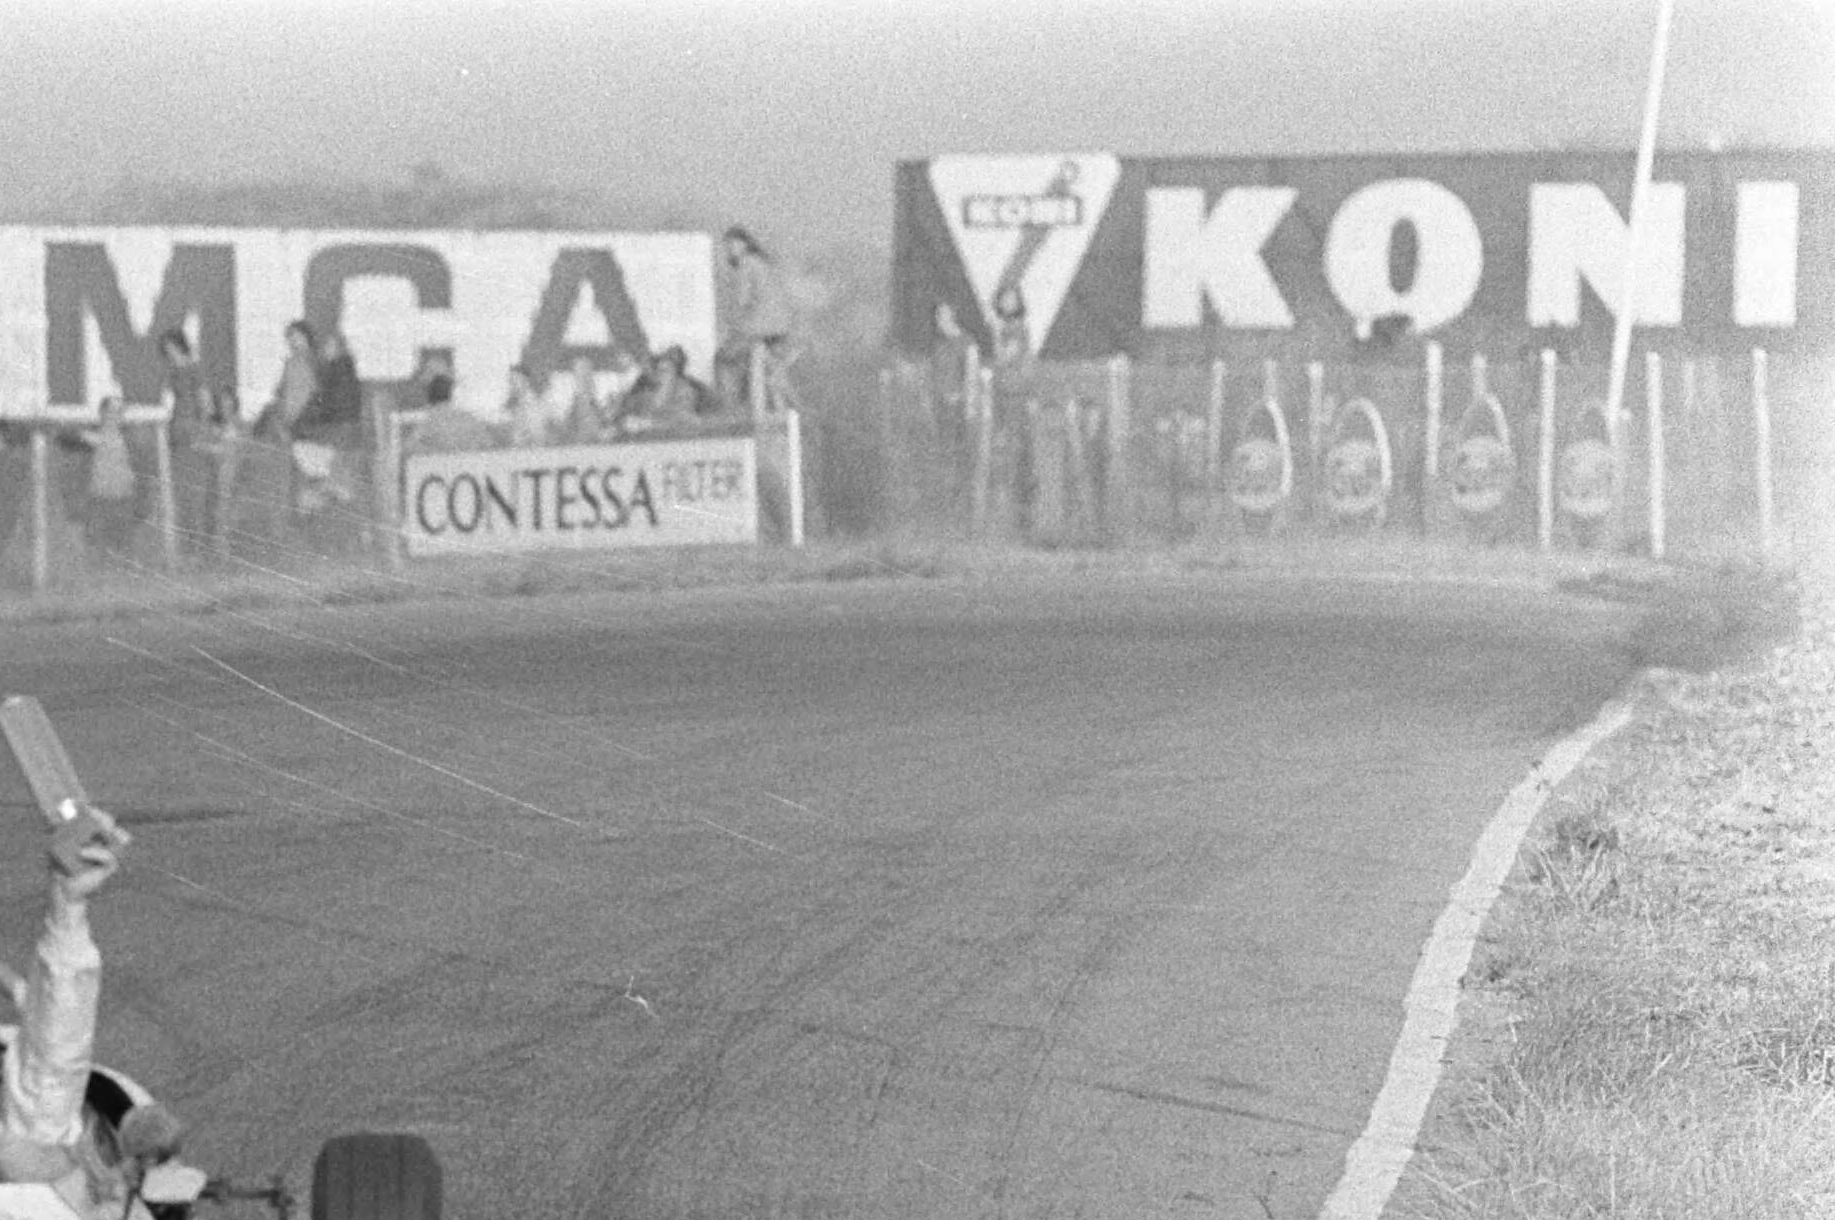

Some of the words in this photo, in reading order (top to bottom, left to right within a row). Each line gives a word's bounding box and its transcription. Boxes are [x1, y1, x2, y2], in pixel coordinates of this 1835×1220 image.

[1141, 176, 1798, 333] KONI
[415, 466, 660, 536] CONTESSA
[662, 459, 744, 503] FILTER
